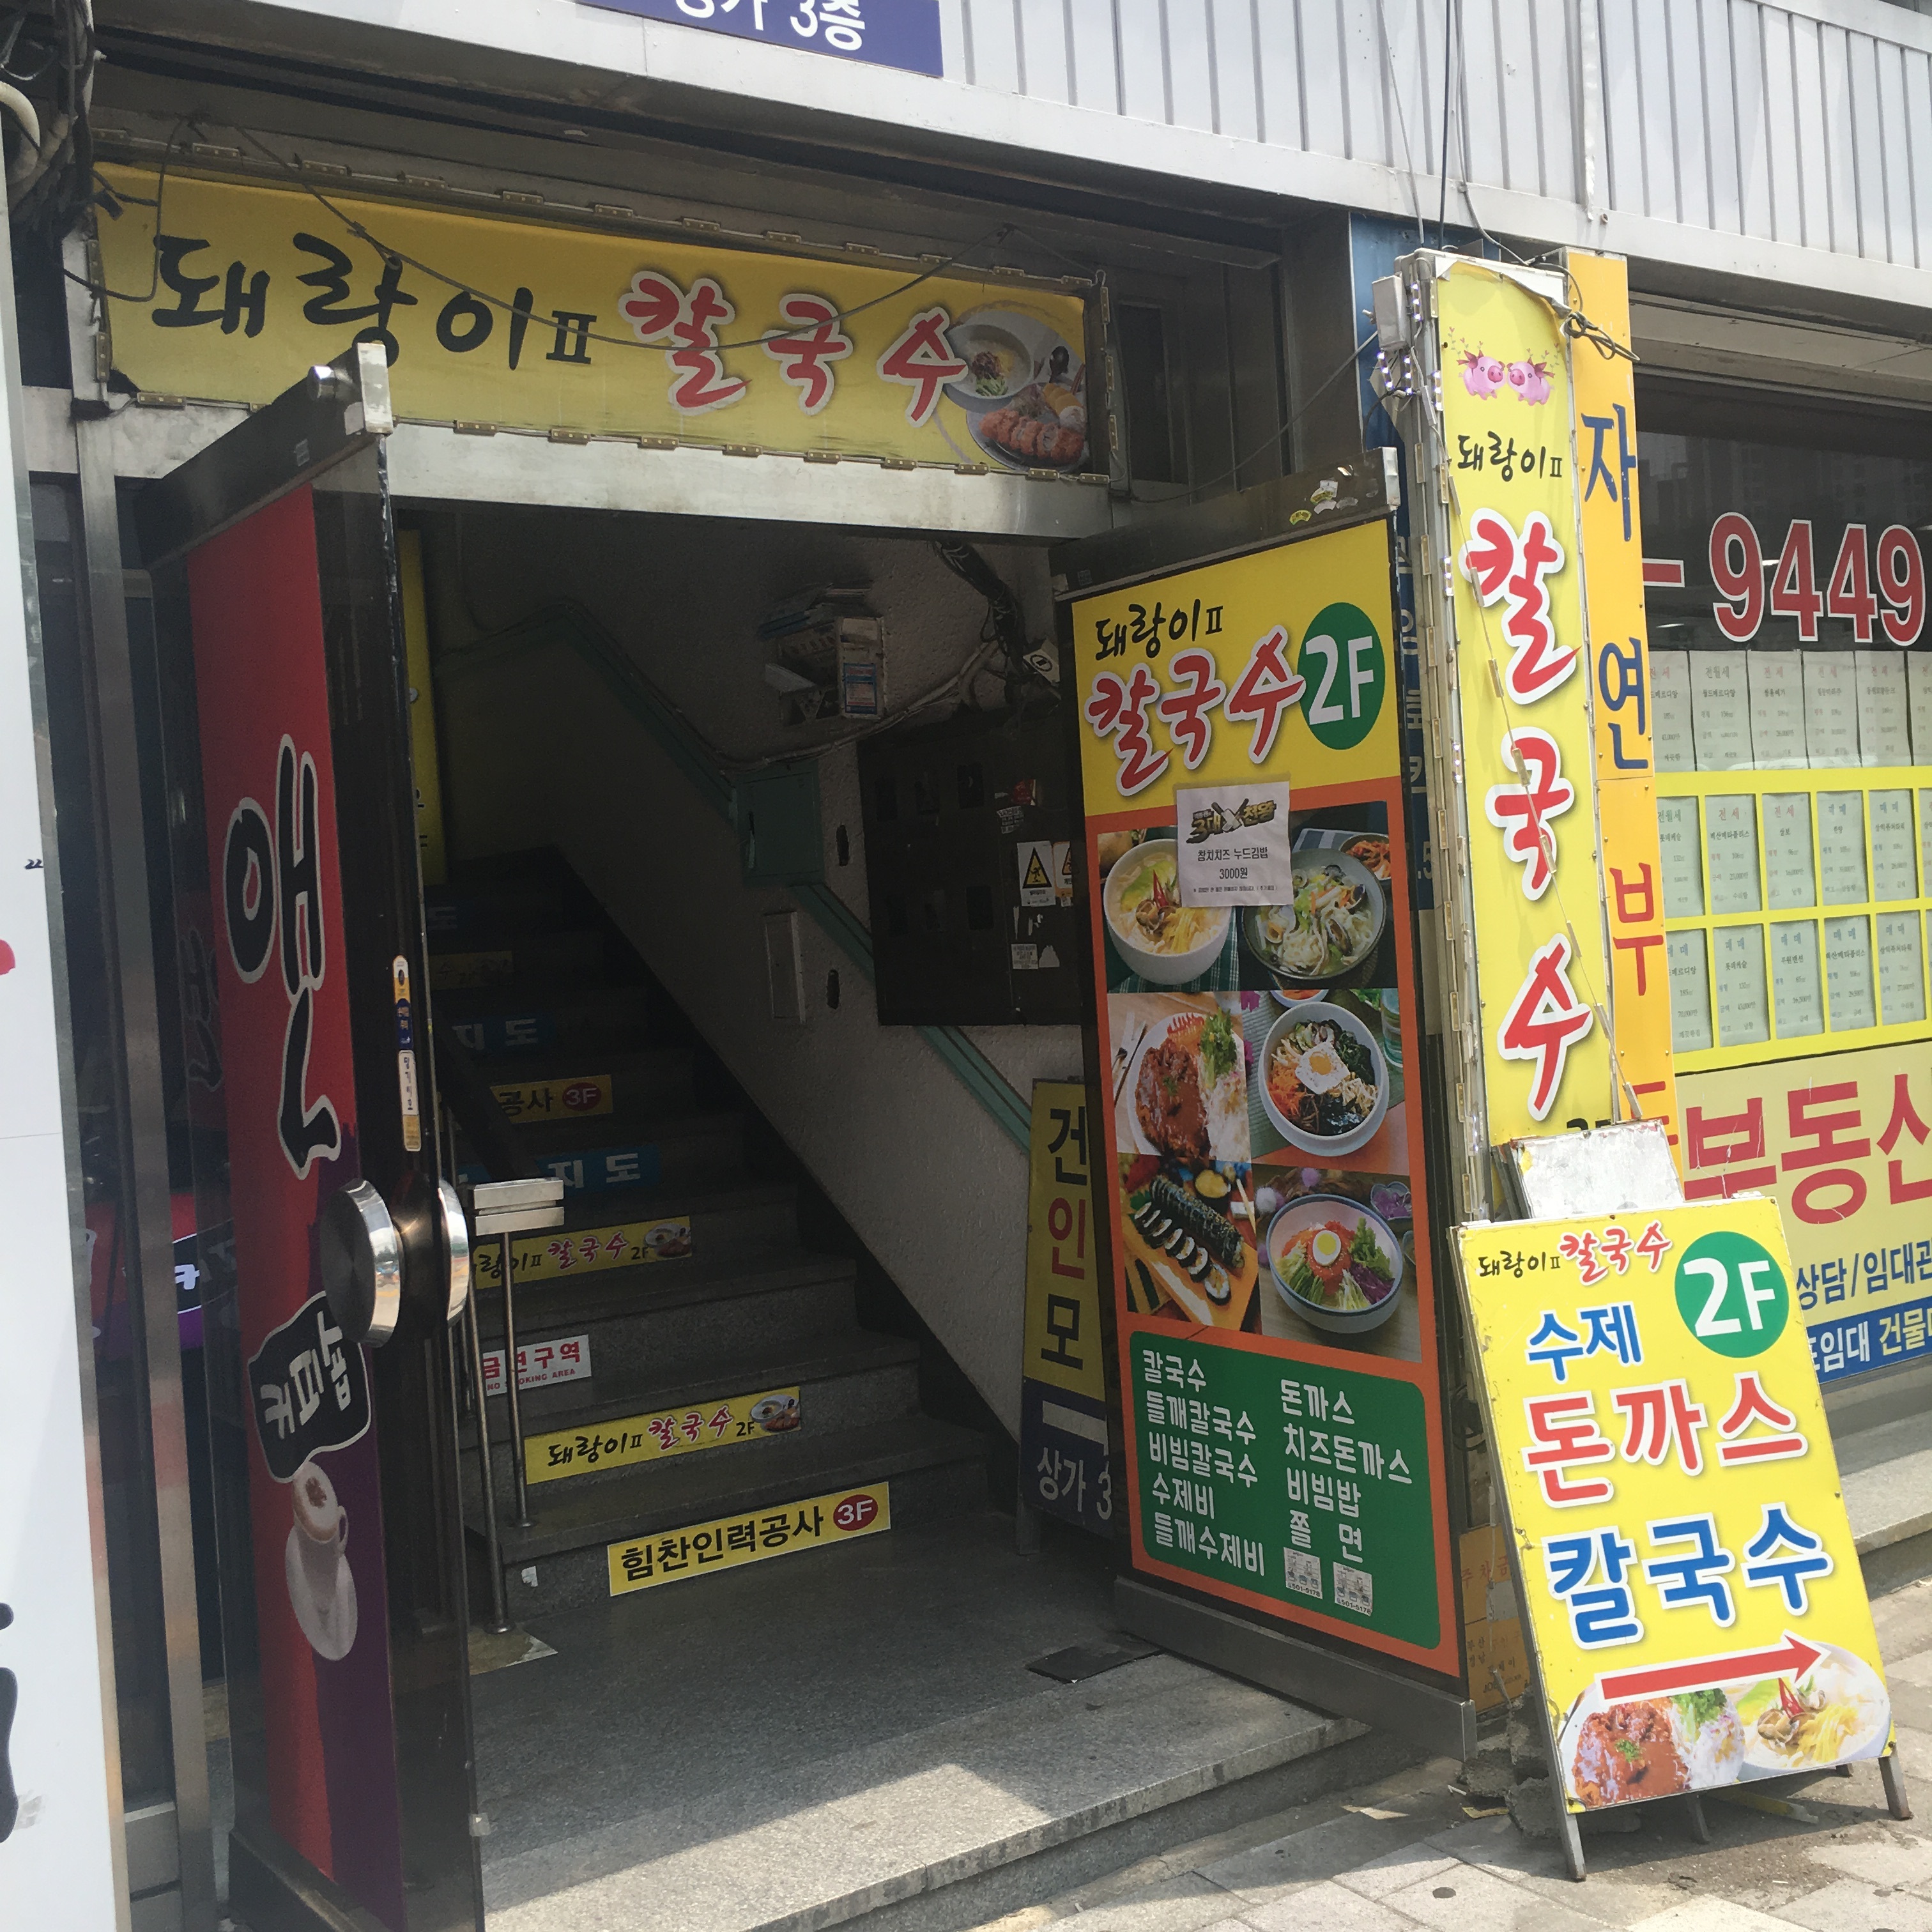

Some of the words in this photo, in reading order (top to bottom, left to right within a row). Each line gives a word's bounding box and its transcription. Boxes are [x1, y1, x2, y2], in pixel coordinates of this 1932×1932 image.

[618, 271, 969, 427] 칼국수
[1085, 625, 1306, 797] 칼국수
[1305, 634, 1374, 726] 2F
[1459, 507, 1593, 1121] 칼국수
[1197, 849, 1230, 862] 참치치즈
[1234, 847, 1268, 861] 누드김밥
[1219, 867, 1248, 880] 3000원
[565, 1087, 599, 1107] 3F
[1684, 1073, 1932, 1224] 부동산
[548, 1232, 627, 1270] 칼국수
[1560, 1220, 1673, 1285] 칼국수
[1683, 1257, 1776, 1337] 2F
[1526, 1301, 1643, 1382] 수제
[1878, 1307, 1932, 1356] 건물
[487, 1383, 500, 1391] NO
[552, 1368, 576, 1379] AREA
[1143, 1349, 1206, 1392] 칼국수
[1280, 1379, 1355, 1424] 돈까스
[648, 1405, 734, 1451] 칼국수
[736, 1421, 755, 1437] 2F
[1146, 1390, 1257, 1445] 들깨칼국수
[1522, 1371, 1808, 1508] 돈까스
[1037, 1446, 1086, 1512] 상가
[1149, 1431, 1258, 1488] 비빔칼국수
[1283, 1422, 1413, 1484] 치즈돈까스
[1152, 1473, 1215, 1519] 수제비
[1286, 1467, 1361, 1518] 비빔밥
[621, 1505, 824, 1582] 힘찬인력공사
[837, 1499, 874, 1526] 3F
[1154, 1512, 1265, 1576] 들깨수제비
[1542, 1502, 1834, 1650] 칼국수
